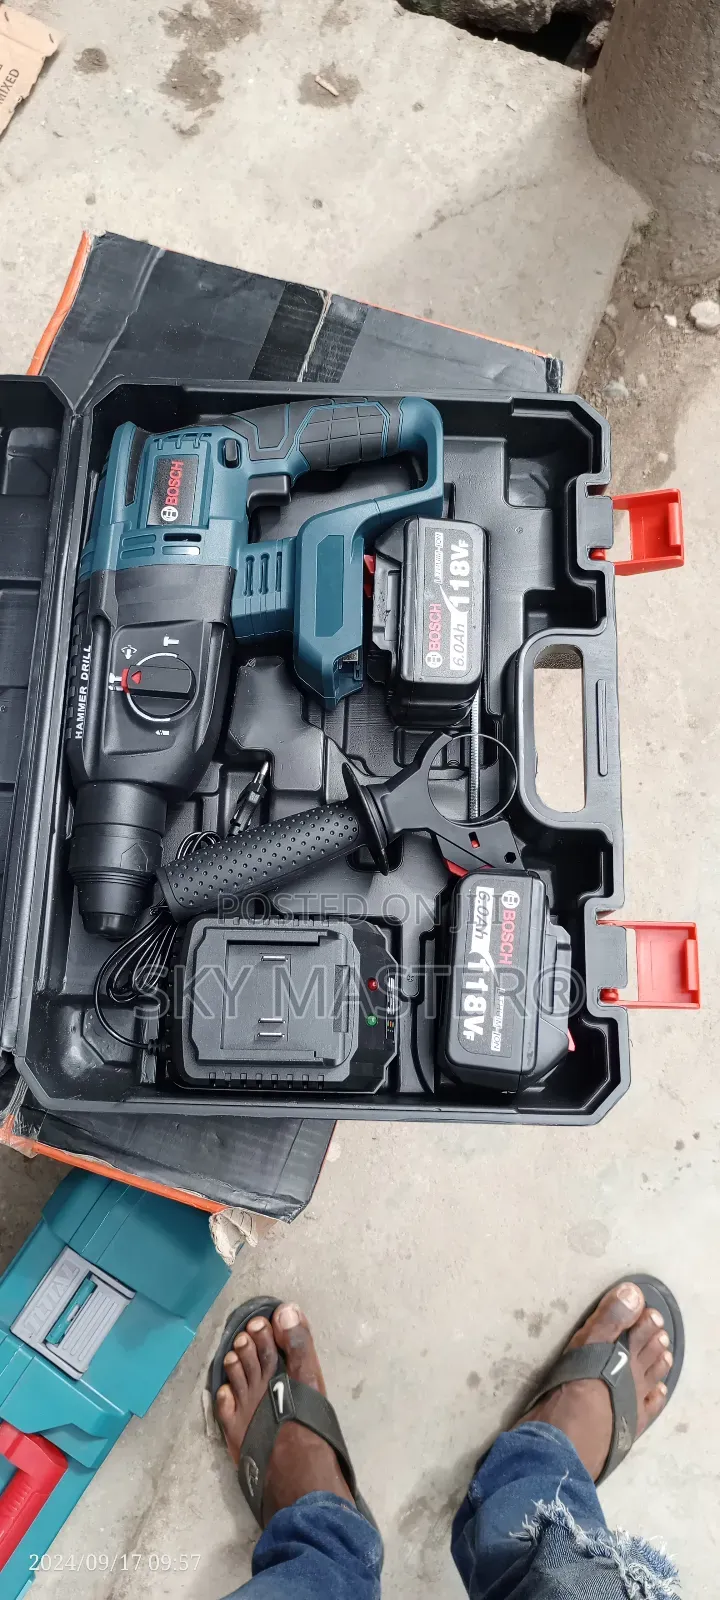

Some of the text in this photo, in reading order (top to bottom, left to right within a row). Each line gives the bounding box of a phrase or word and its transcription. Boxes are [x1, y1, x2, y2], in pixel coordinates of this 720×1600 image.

[165, 460, 184, 506] BOSCH
[428, 603, 442, 651] BOSCH
[453, 623, 465, 667] 6.0Ah
[75, 645, 92, 739] HAMMER DRILL
[474, 890, 490, 940] 6.0Ah
[498, 909, 516, 965] BOSCH
